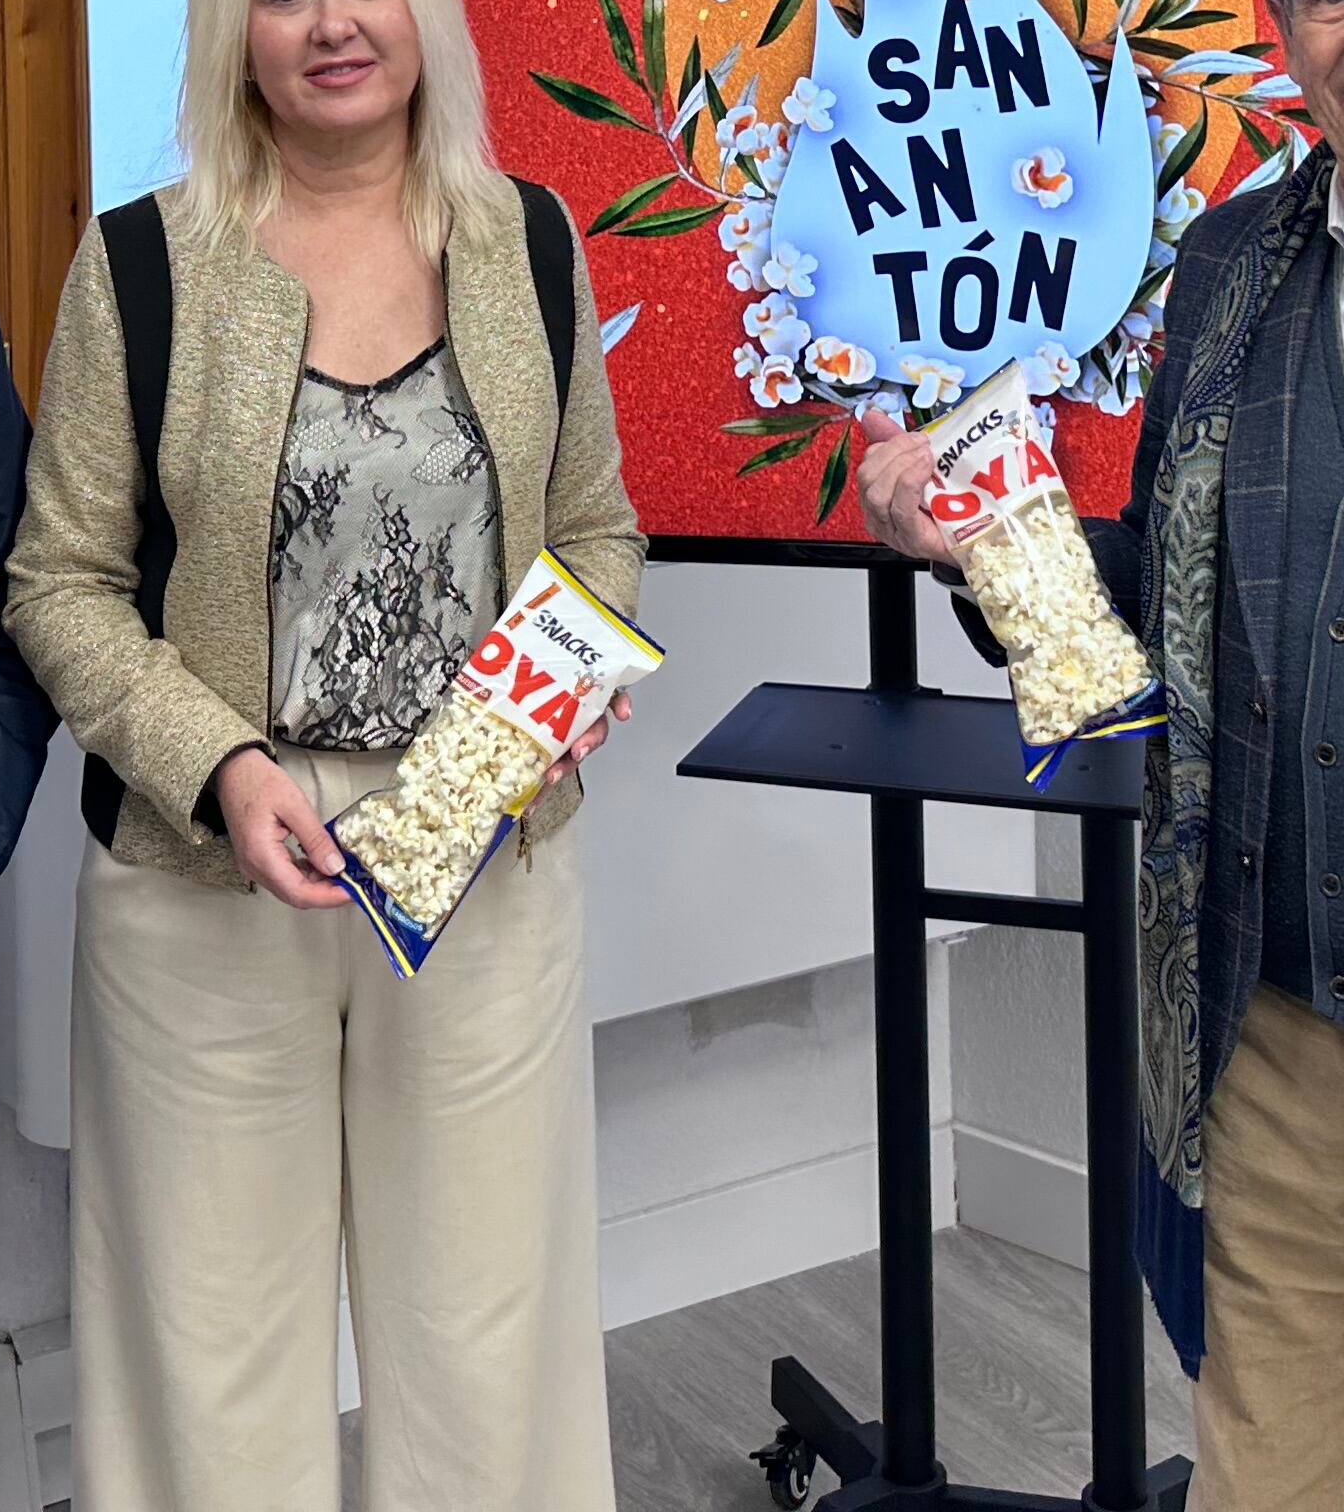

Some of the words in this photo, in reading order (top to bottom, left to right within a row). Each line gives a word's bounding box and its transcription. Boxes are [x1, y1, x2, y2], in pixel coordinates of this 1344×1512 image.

[830, 128, 977, 236] AN
[872, 229, 1077, 351] TÓN
[930, 438, 1058, 522] OYA
[936, 408, 1004, 478] SNACKS
[532, 609, 604, 666] SNACKS
[468, 630, 580, 744] OYA
